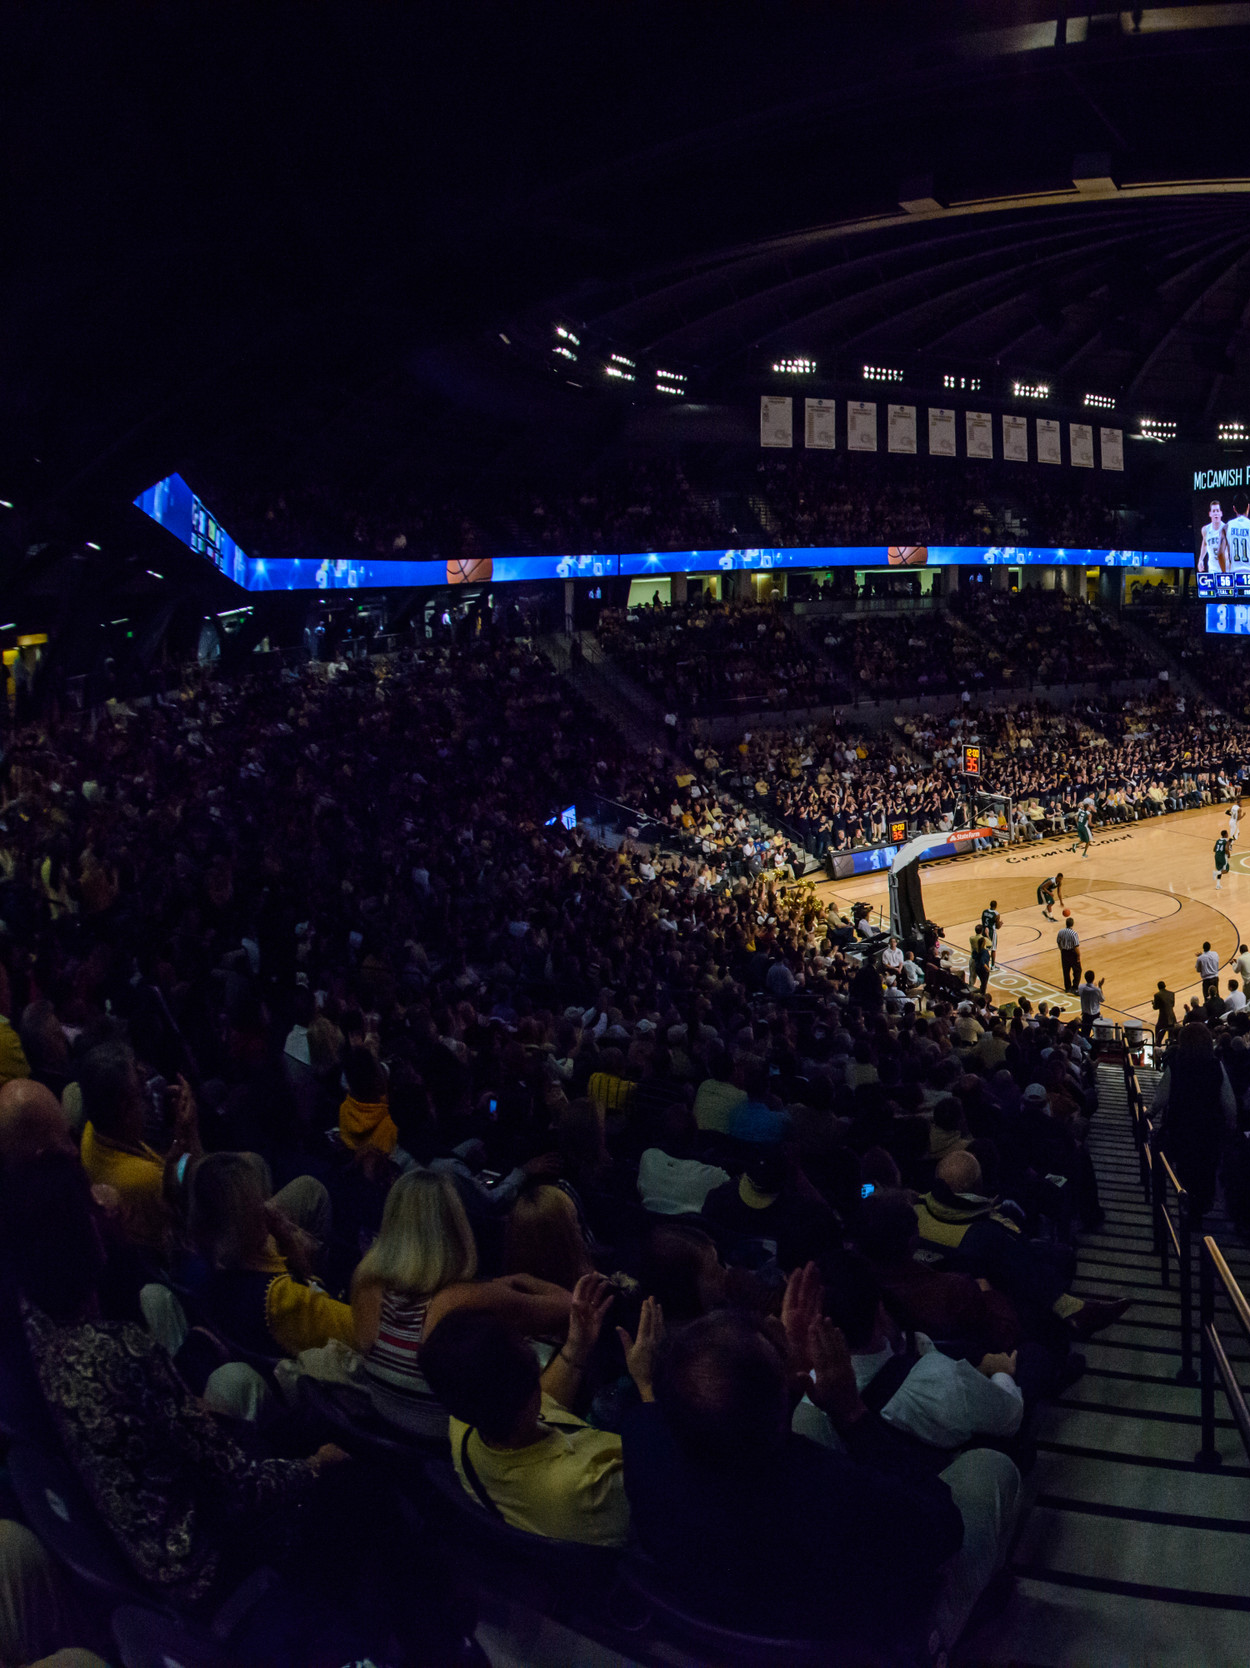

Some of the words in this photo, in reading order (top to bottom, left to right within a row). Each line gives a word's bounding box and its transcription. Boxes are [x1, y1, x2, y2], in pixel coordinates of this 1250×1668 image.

[1233, 537, 1249, 562] 11
[1220, 575, 1231, 587] 56
[1217, 604, 1227, 632] 3
[967, 748, 979, 758] 12:00
[967, 757, 978, 772] 35
[893, 830, 903, 840] 35
